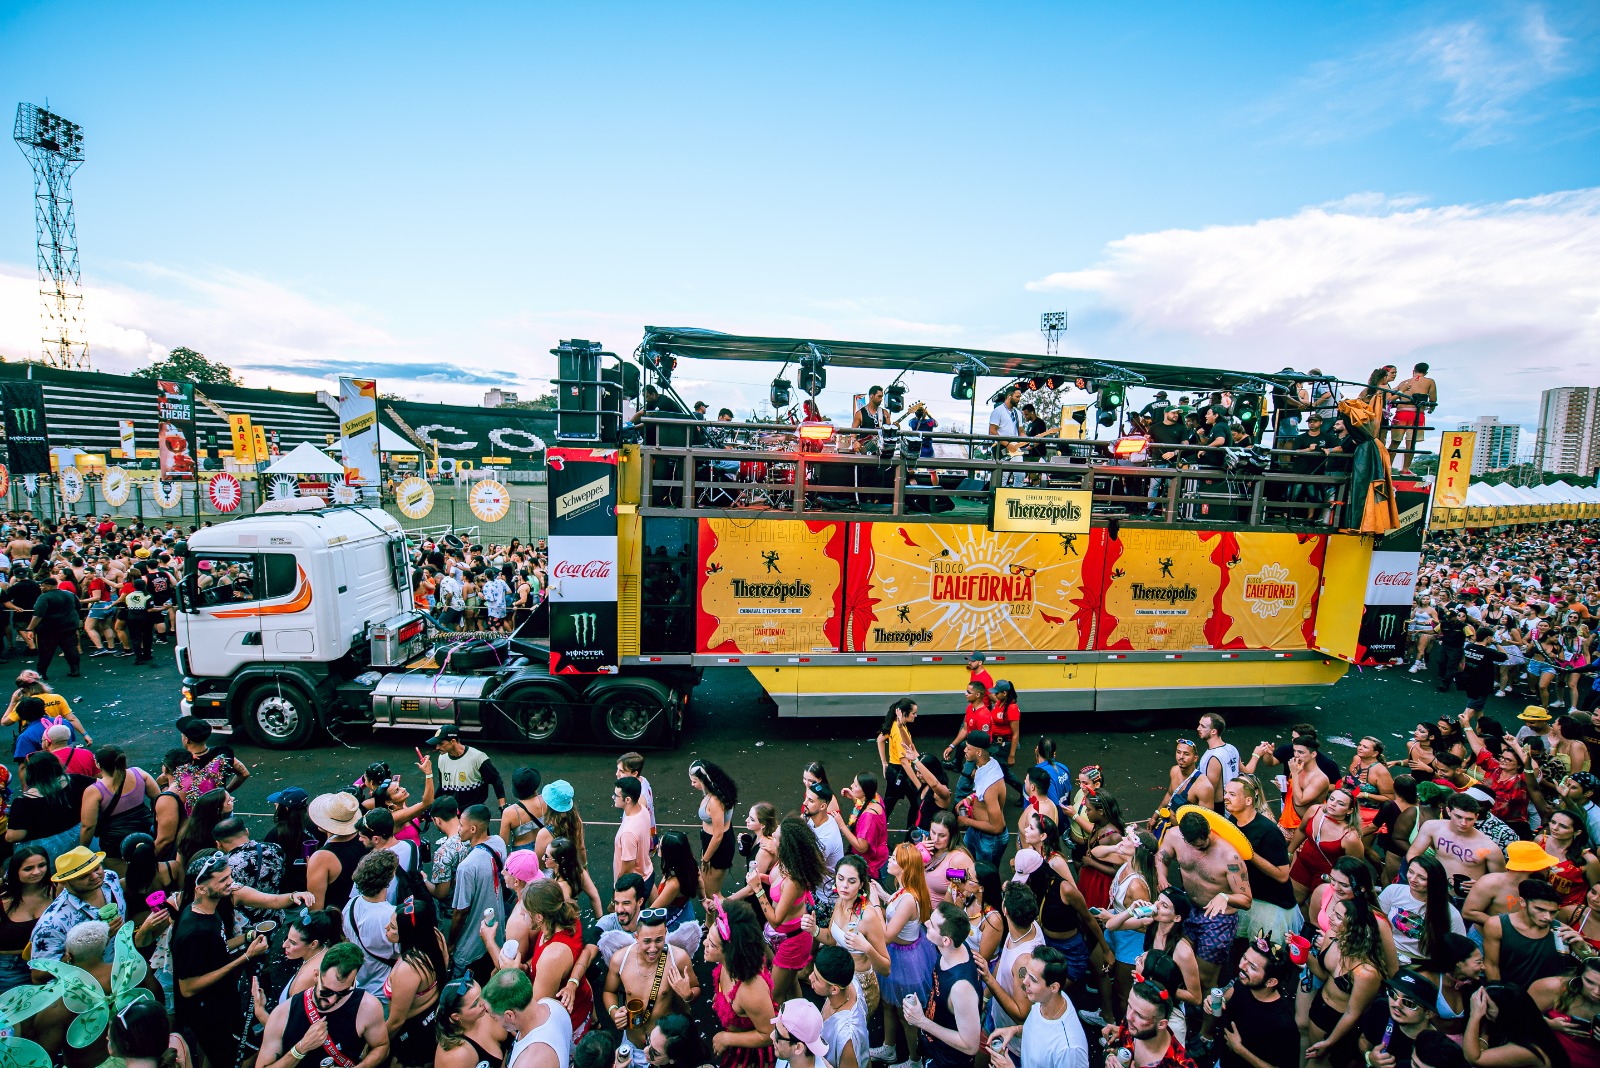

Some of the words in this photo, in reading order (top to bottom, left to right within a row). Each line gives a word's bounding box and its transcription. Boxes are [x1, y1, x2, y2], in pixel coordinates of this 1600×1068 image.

[237, 418, 246, 441] BAR
[345, 416, 374, 431] Schweppes
[1450, 436, 1462, 472] BAR
[1448, 477, 1454, 487] 1
[562, 484, 604, 509] Schweppes
[1006, 498, 1082, 525] Therezópolis
[554, 560, 612, 578] Coca-Cola
[934, 562, 964, 574] BLOCO
[1374, 570, 1412, 586] Coca-Cola
[730, 578, 812, 603] Therezópolis
[1130, 582, 1197, 605] Therezópolis
[1010, 604, 1030, 614] 2023
[873, 627, 933, 646] Therezópolis
